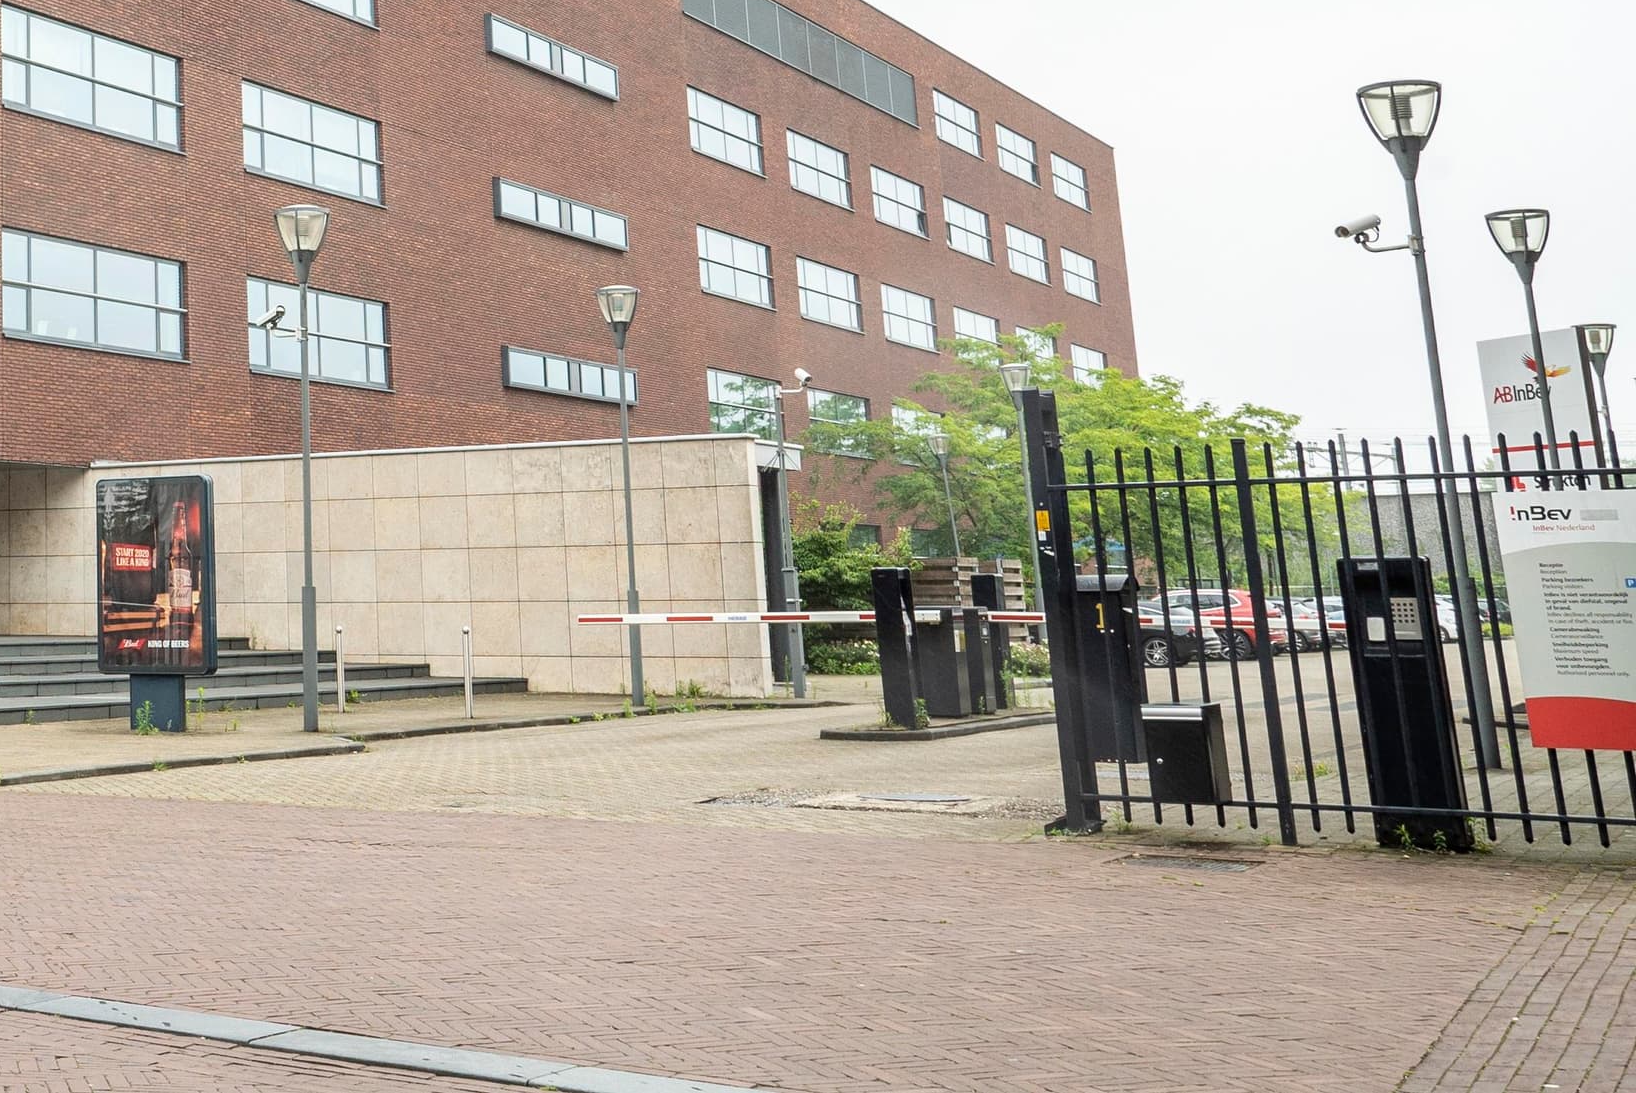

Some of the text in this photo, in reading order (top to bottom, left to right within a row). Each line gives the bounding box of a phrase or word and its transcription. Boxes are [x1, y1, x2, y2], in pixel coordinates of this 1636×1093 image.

[1556, 524, 1596, 532] Nederland
[115, 547, 134, 557] START
[129, 557, 135, 566] A
[1095, 603, 1104, 628] 1
